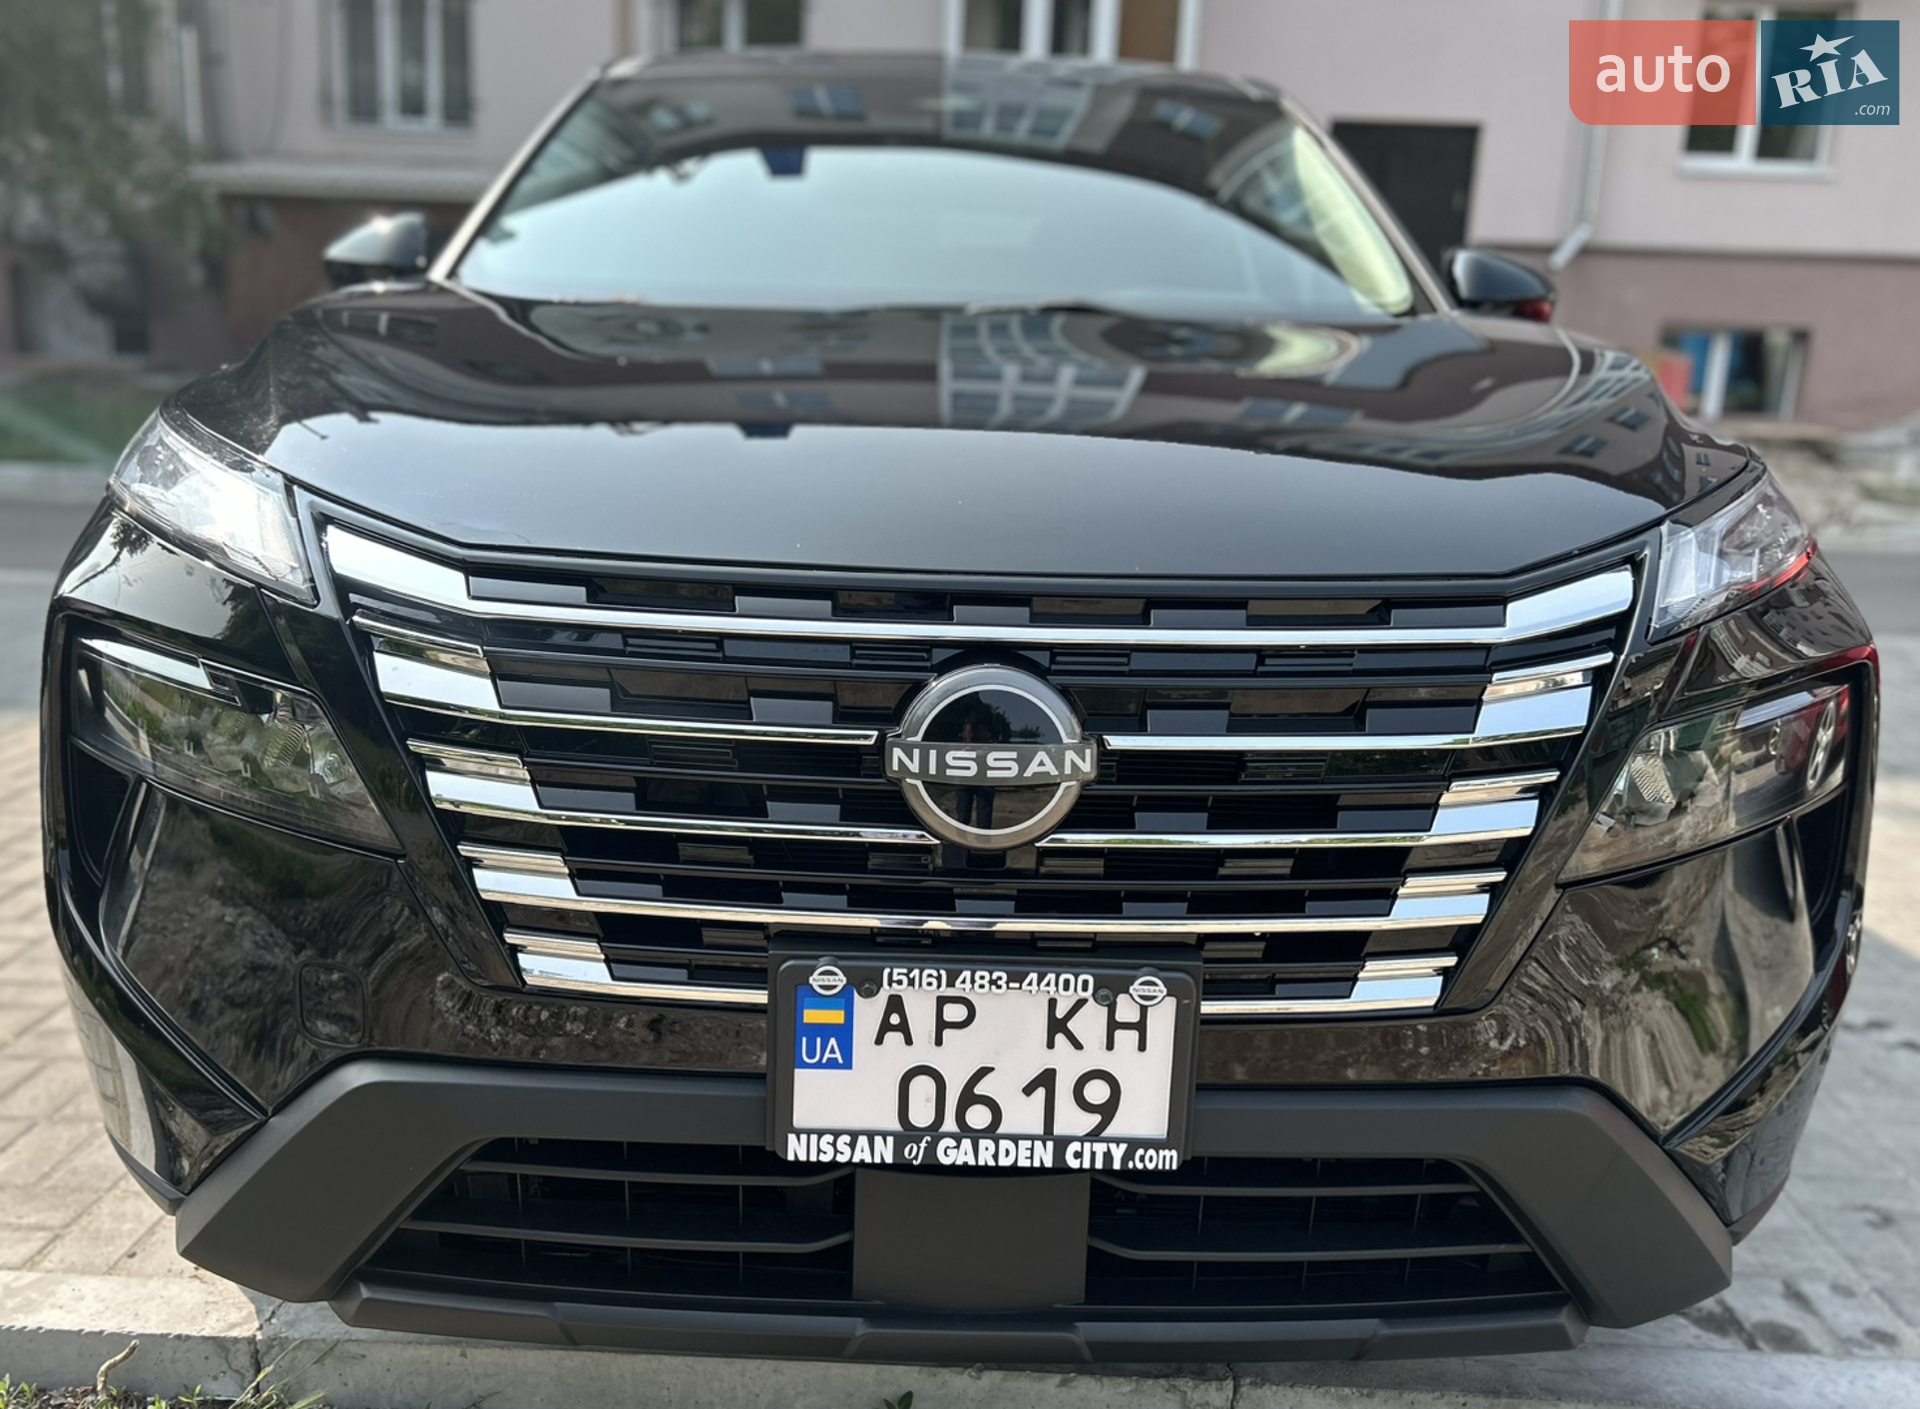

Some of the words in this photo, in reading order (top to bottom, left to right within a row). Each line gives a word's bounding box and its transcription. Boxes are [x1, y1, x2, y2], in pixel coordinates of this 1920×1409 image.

[892, 747, 1092, 778] NISSAN
[882, 967, 948, 992] (516)
[954, 970, 1094, 997] 483-4400
[873, 994, 977, 1047] AP
[1046, 998, 1149, 1052] KH
[801, 1037, 844, 1064] UA
[897, 1064, 1122, 1137] 0619
[787, 1133, 894, 1164] NISSAN
[904, 1136, 931, 1165] of
[936, 1137, 1054, 1168] GARDEN
[1065, 1142, 1179, 1170] CITY.com
